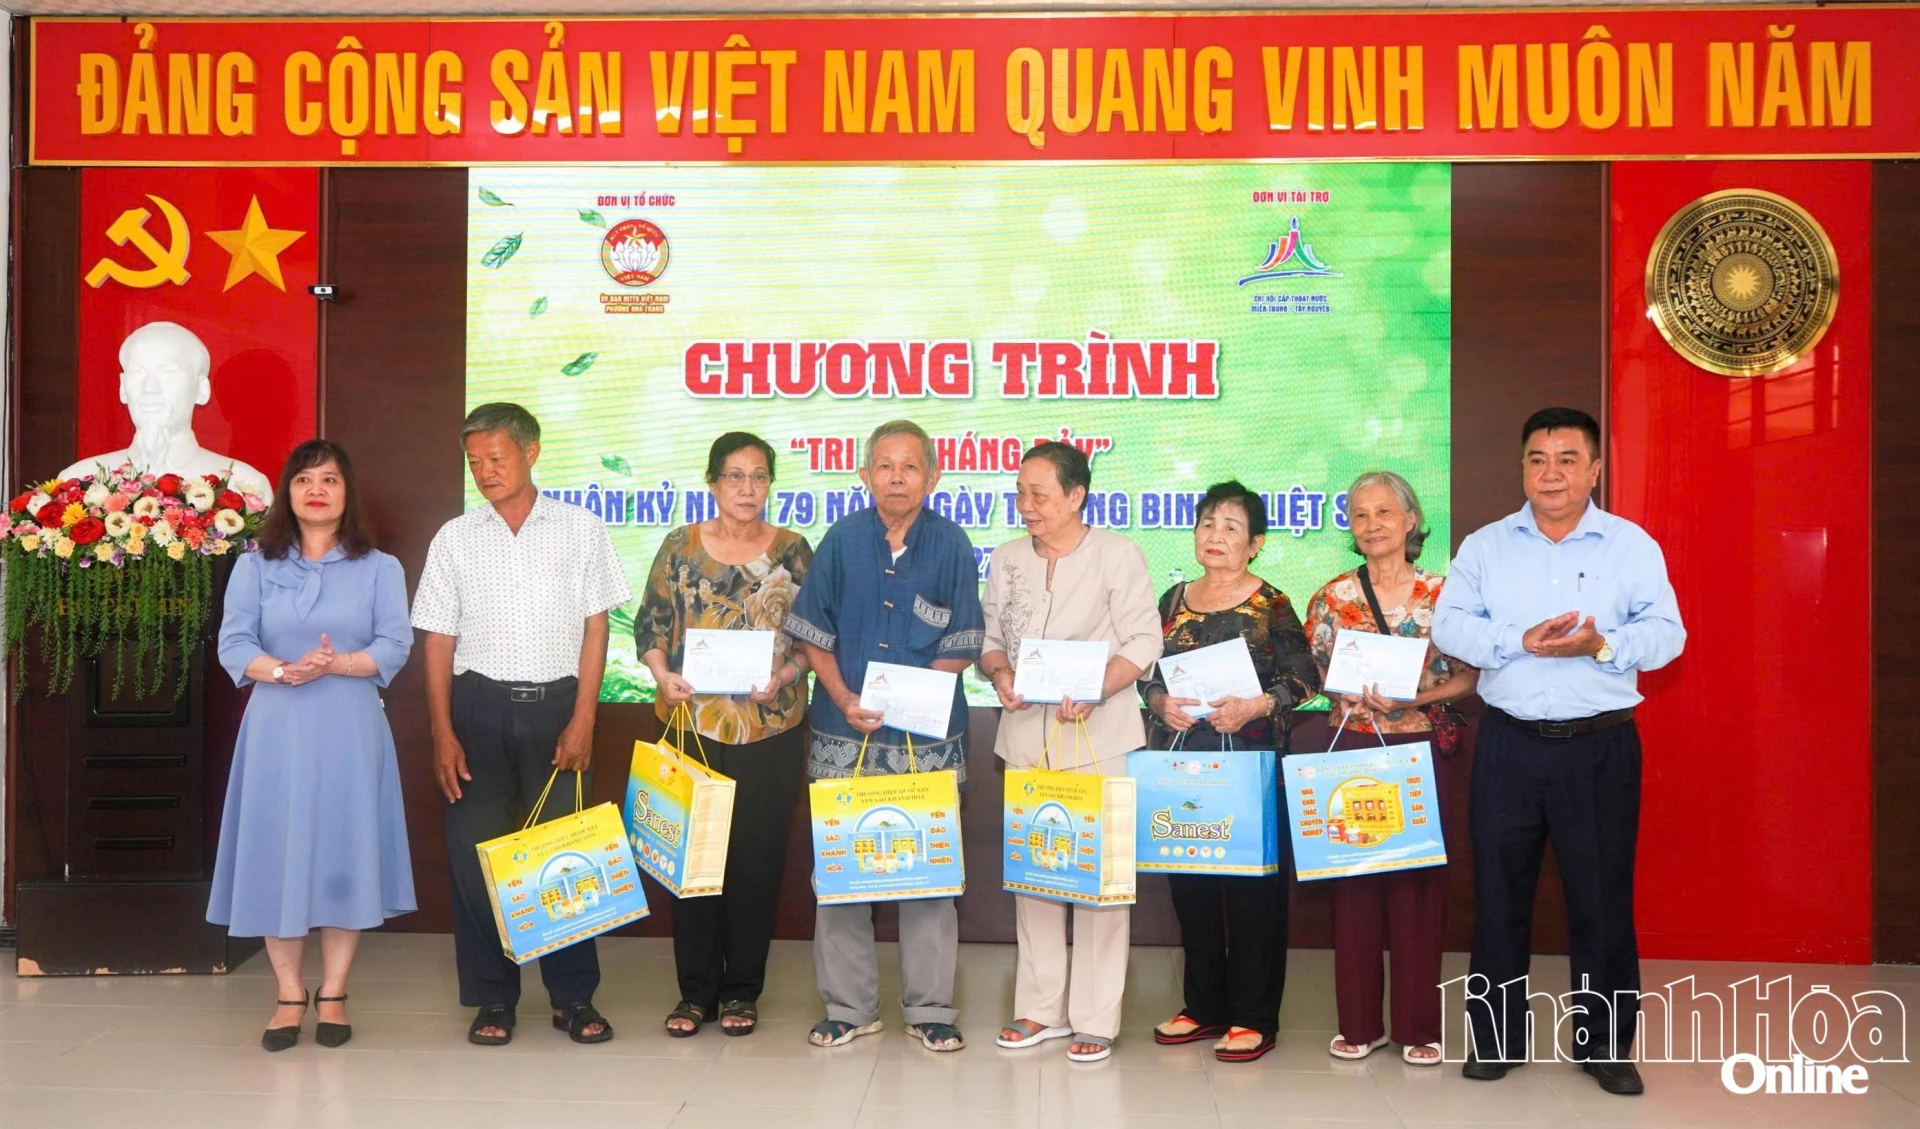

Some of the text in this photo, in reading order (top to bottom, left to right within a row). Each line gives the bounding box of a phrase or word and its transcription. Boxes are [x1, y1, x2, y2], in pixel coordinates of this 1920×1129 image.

[77, 21, 1873, 156] ĐẢNG CỘNG SẢN VIỆT NAM QUANG VINH MUÔN NĂM
[597, 192, 675, 209] ĐƠN VỊ TỔ CHỨC
[1252, 190, 1330, 204] ĐƠN VỊ TÀI TRỢ
[685, 332, 1218, 397] CHƯƠNG TRÌNH
[636, 481, 675, 523] KỶ
[777, 492, 815, 525] 79
[826, 485, 877, 524] NĂ
[1141, 493, 1207, 526] BIN
[635, 790, 681, 847] Sanest
[930, 809, 945, 818] YẾN
[824, 818, 840, 827] YẾN
[1152, 811, 1230, 840] Sanest
[603, 842, 619, 852] YẾN
[930, 840, 950, 849] THIÊN
[930, 855, 952, 865] NHIÊN
[507, 878, 523, 889] YẾN
[613, 882, 634, 895] NHIÊN
